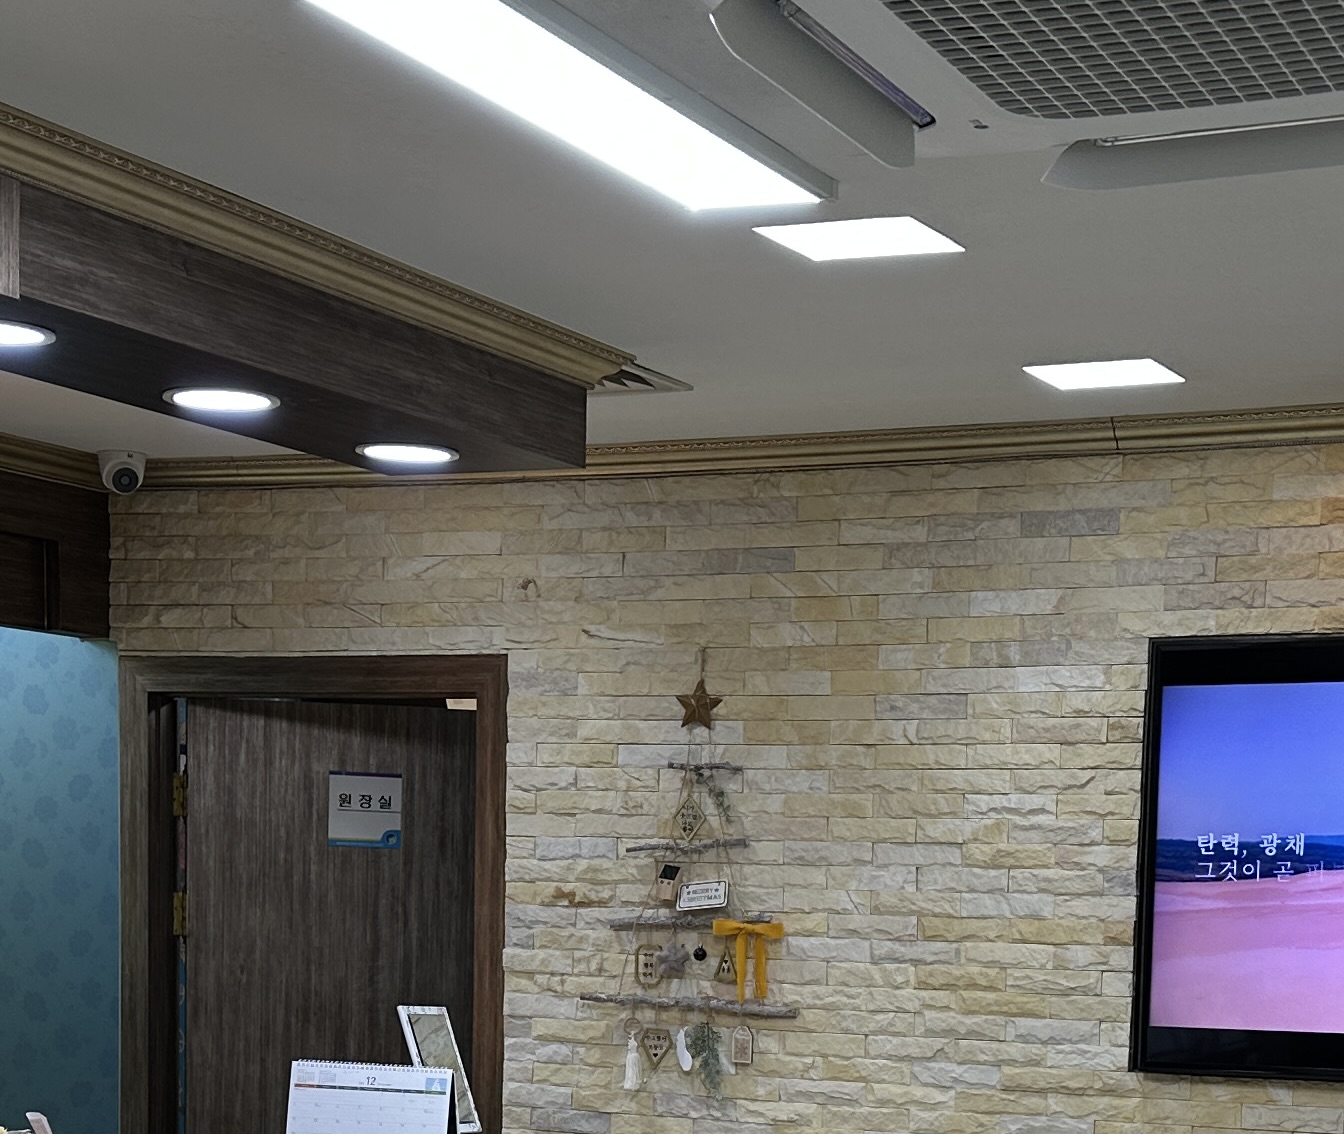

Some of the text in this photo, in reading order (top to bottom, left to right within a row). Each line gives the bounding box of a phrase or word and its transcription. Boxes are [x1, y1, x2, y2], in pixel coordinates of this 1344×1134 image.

[338, 793, 392, 809] 원장실
[1197, 832, 1305, 859] 탄력, 광채
[1194, 859, 1295, 883] 그것이 곧
[366, 1076, 376, 1086] 12
